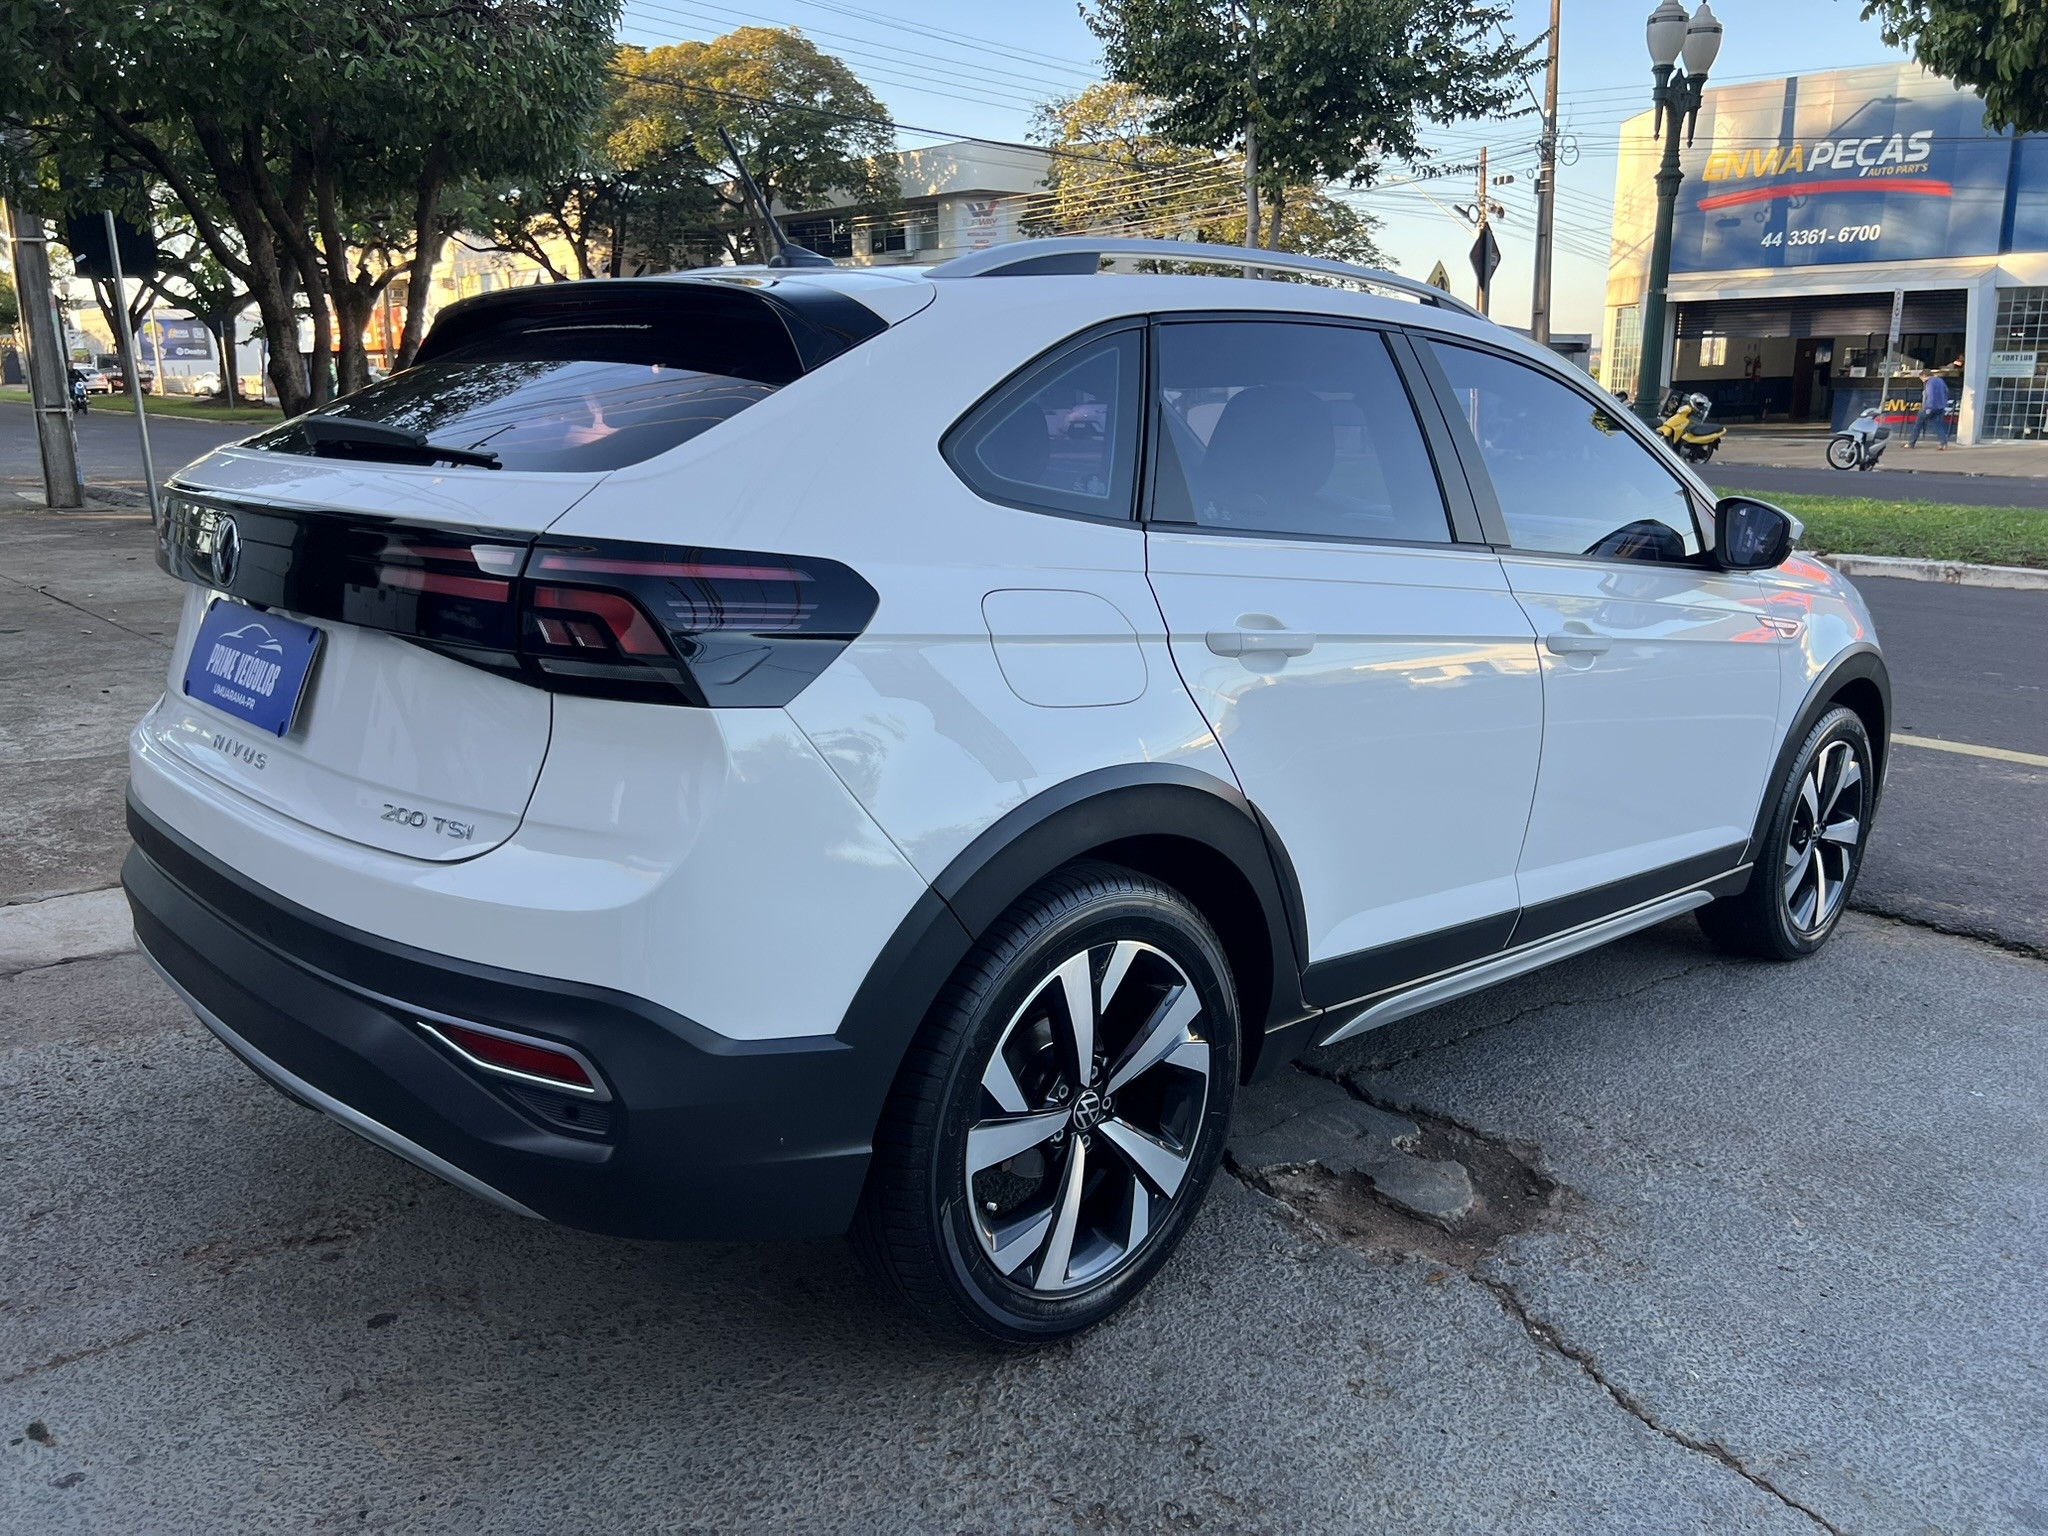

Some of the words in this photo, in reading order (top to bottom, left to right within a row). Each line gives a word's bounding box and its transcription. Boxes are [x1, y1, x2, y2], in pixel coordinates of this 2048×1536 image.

[1702, 143, 1804, 182] ENVIA
[1806, 130, 1934, 177] PEÇAS
[1867, 166, 1894, 177] AUTO
[1760, 232, 1783, 248] 44
[1787, 224, 1881, 247] 3361-6700
[206, 643, 241, 681] PRIME
[233, 650, 282, 698] VEÍCULOS
[213, 683, 257, 710] UMUARAMA-PR
[213, 734, 268, 771] NIVUS
[380, 803, 428, 829] 200
[432, 816, 475, 841] TSI
